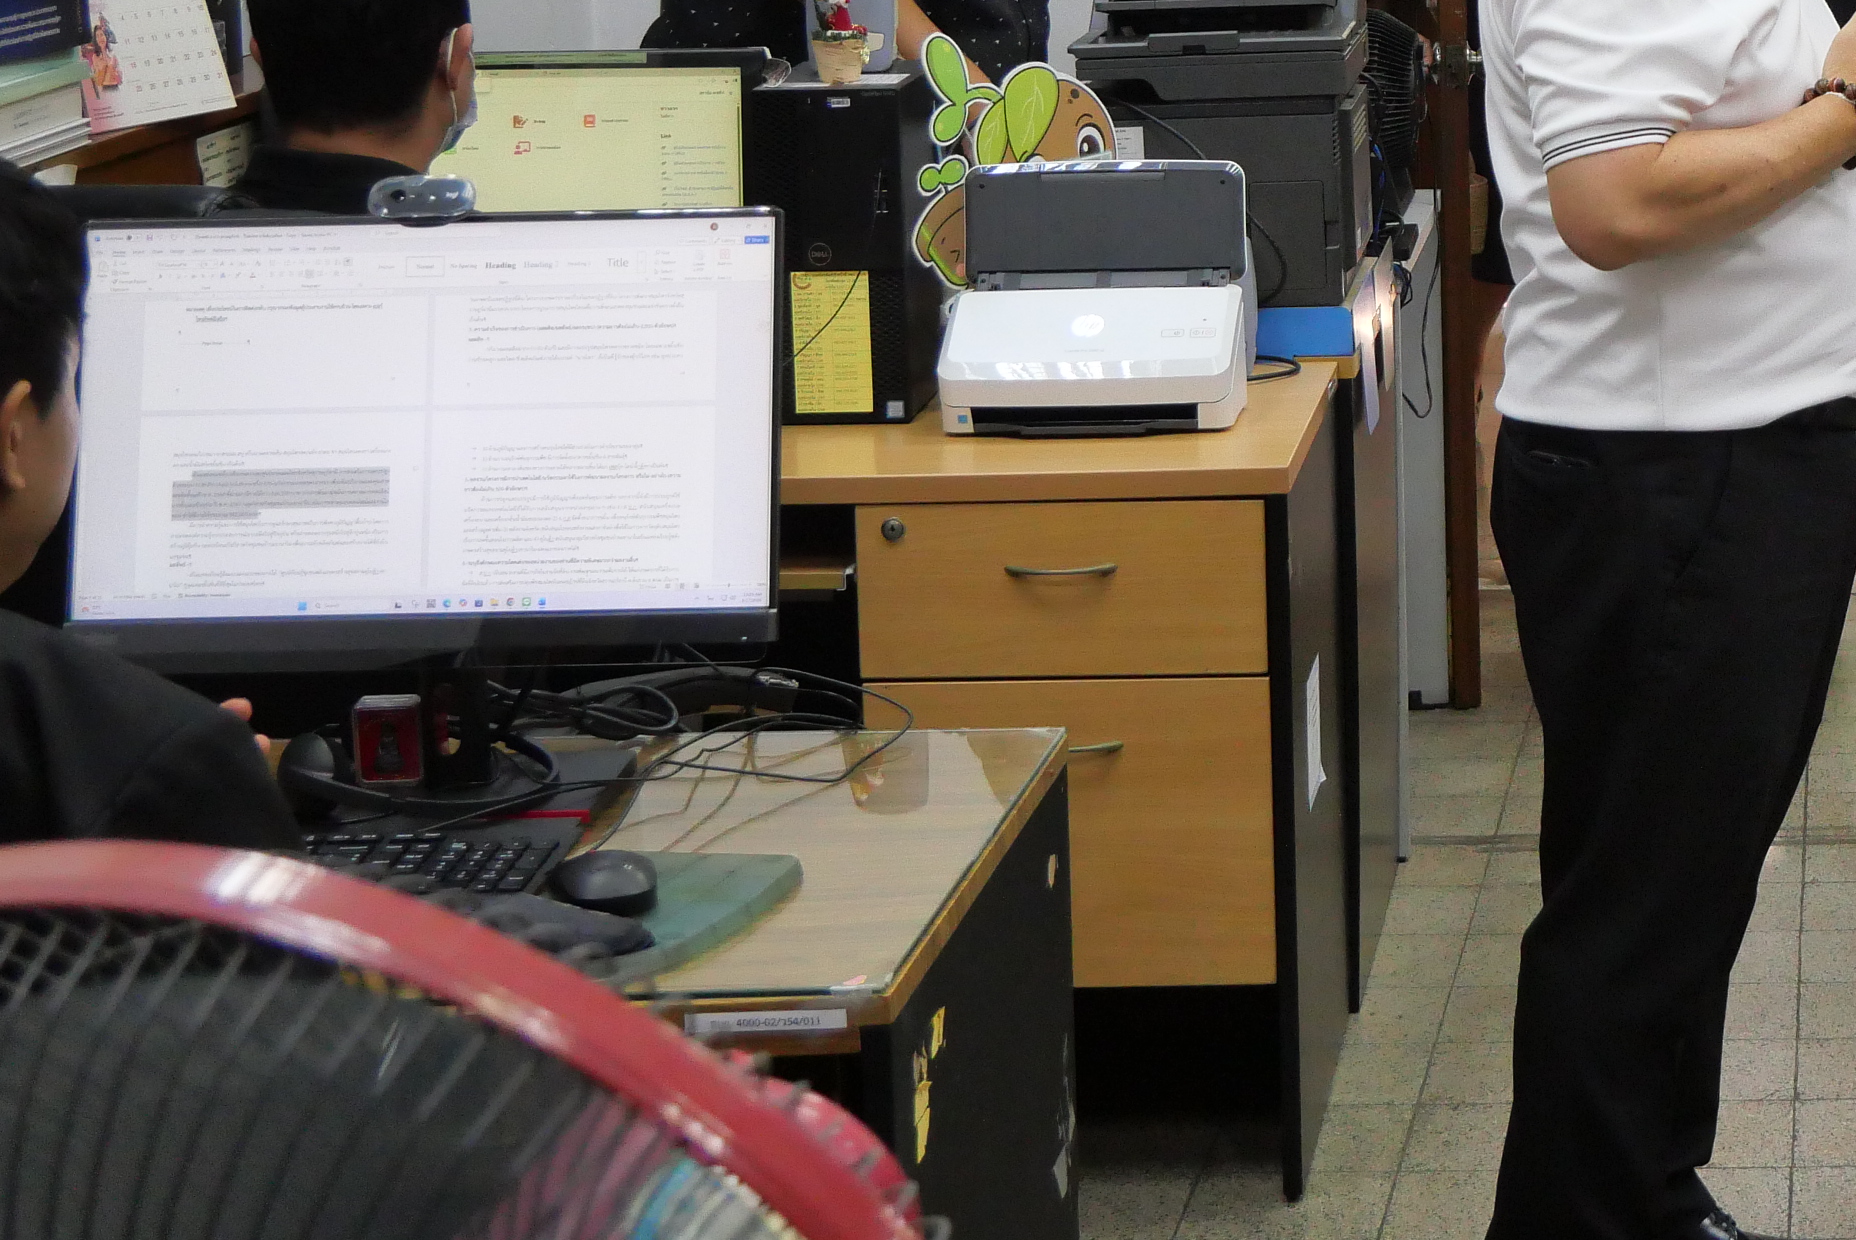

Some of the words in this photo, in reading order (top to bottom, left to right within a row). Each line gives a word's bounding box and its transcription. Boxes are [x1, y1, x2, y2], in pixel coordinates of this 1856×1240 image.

[485, 260, 516, 271] Heading
[523, 260, 553, 270] Heading
[607, 258, 629, 269] Title
